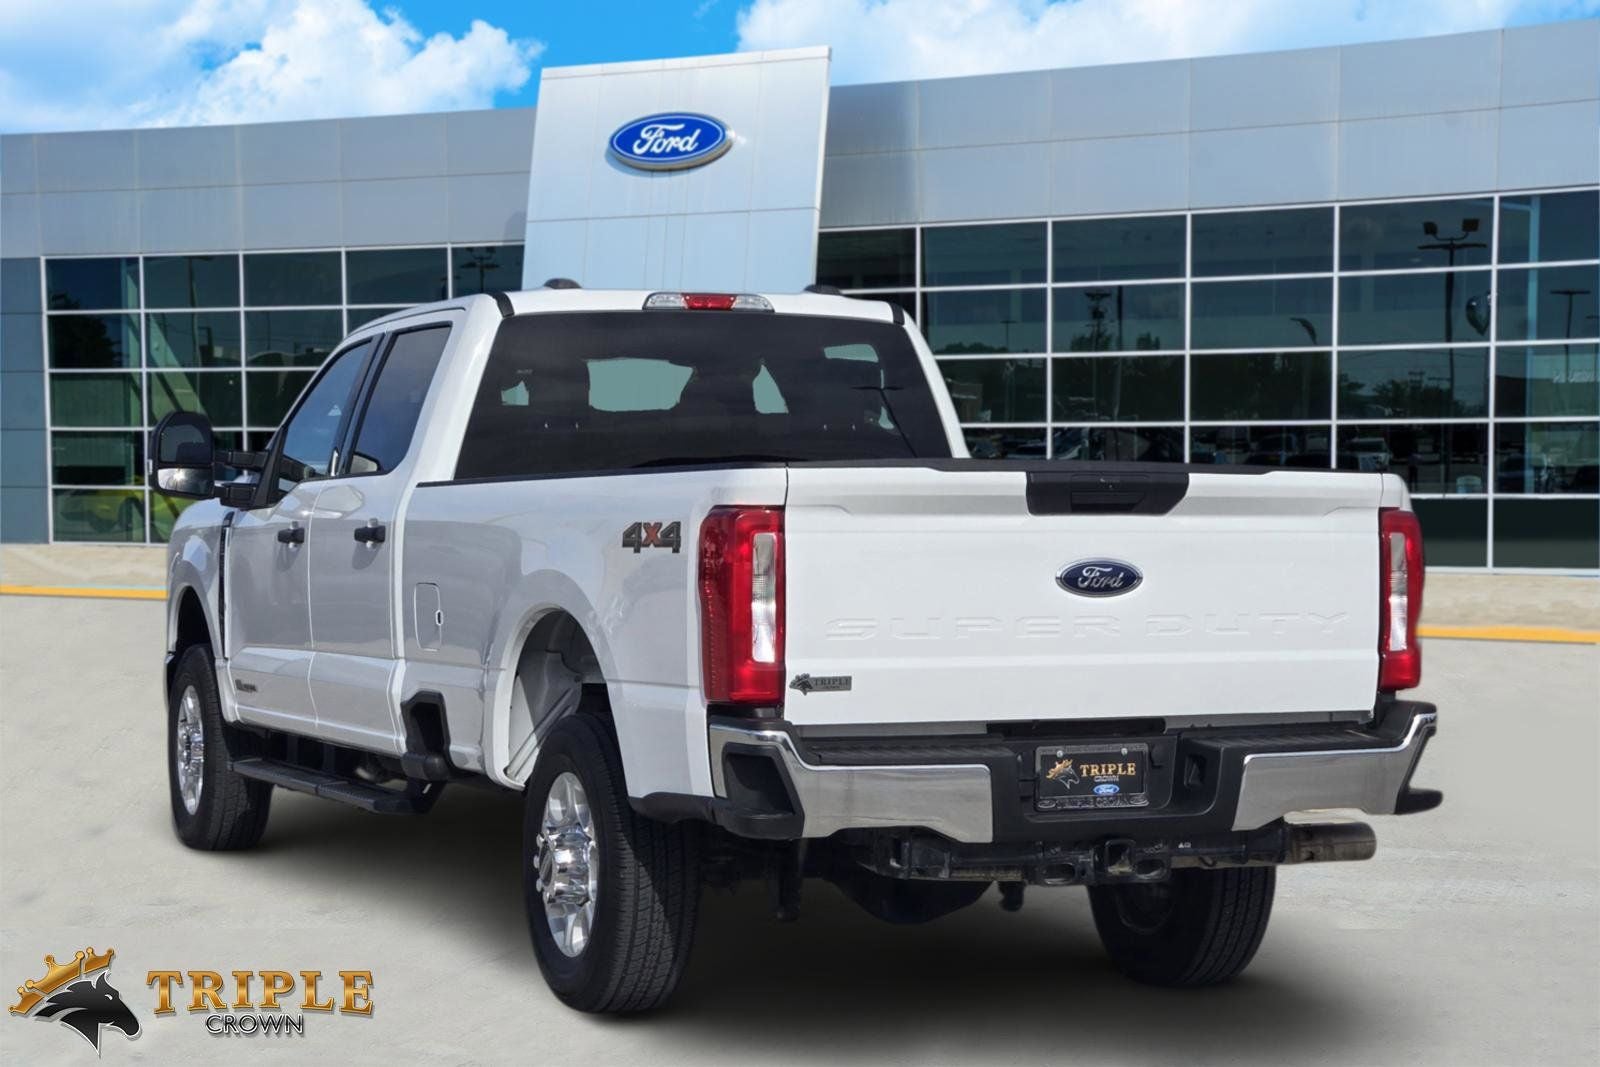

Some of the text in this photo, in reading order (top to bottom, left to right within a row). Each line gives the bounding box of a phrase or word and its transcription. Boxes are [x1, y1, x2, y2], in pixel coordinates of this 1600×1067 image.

[633, 124, 701, 155] Ford
[1078, 566, 1125, 588] Ford
[824, 611, 1350, 641] SUPER DUTY
[1080, 763, 1136, 777] TRIPLE
